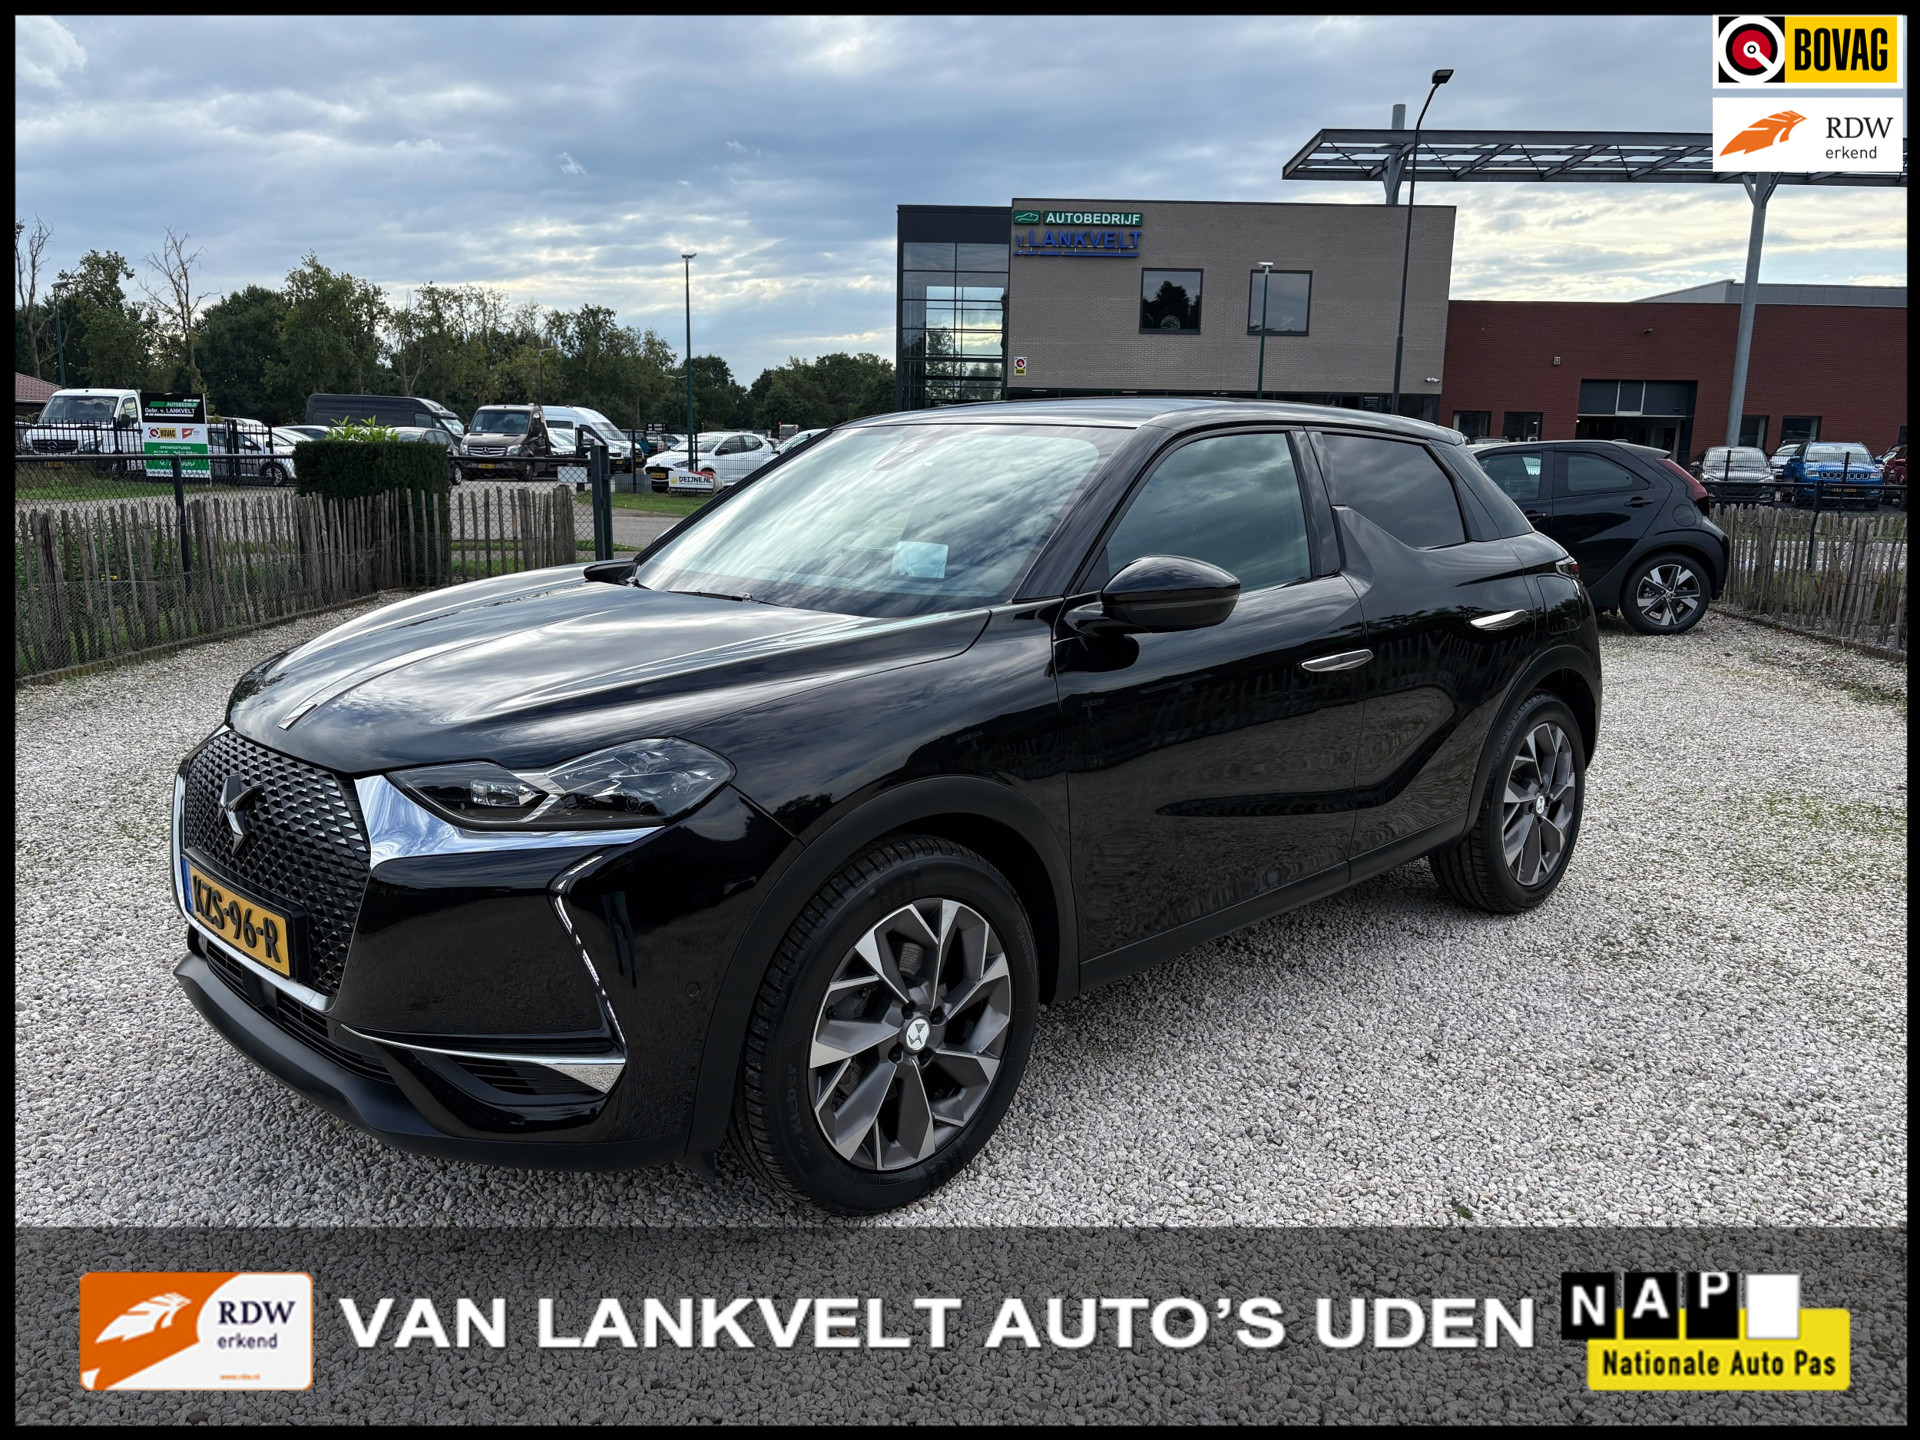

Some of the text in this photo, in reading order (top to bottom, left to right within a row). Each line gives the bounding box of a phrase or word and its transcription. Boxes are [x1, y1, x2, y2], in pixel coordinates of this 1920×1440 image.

[1045, 212, 1140, 225] AUTOBEDRIJF
[1029, 228, 1142, 249] LANKVELT
[160, 429, 176, 438] BOVAG
[192, 874, 282, 964] KZS-96-R
